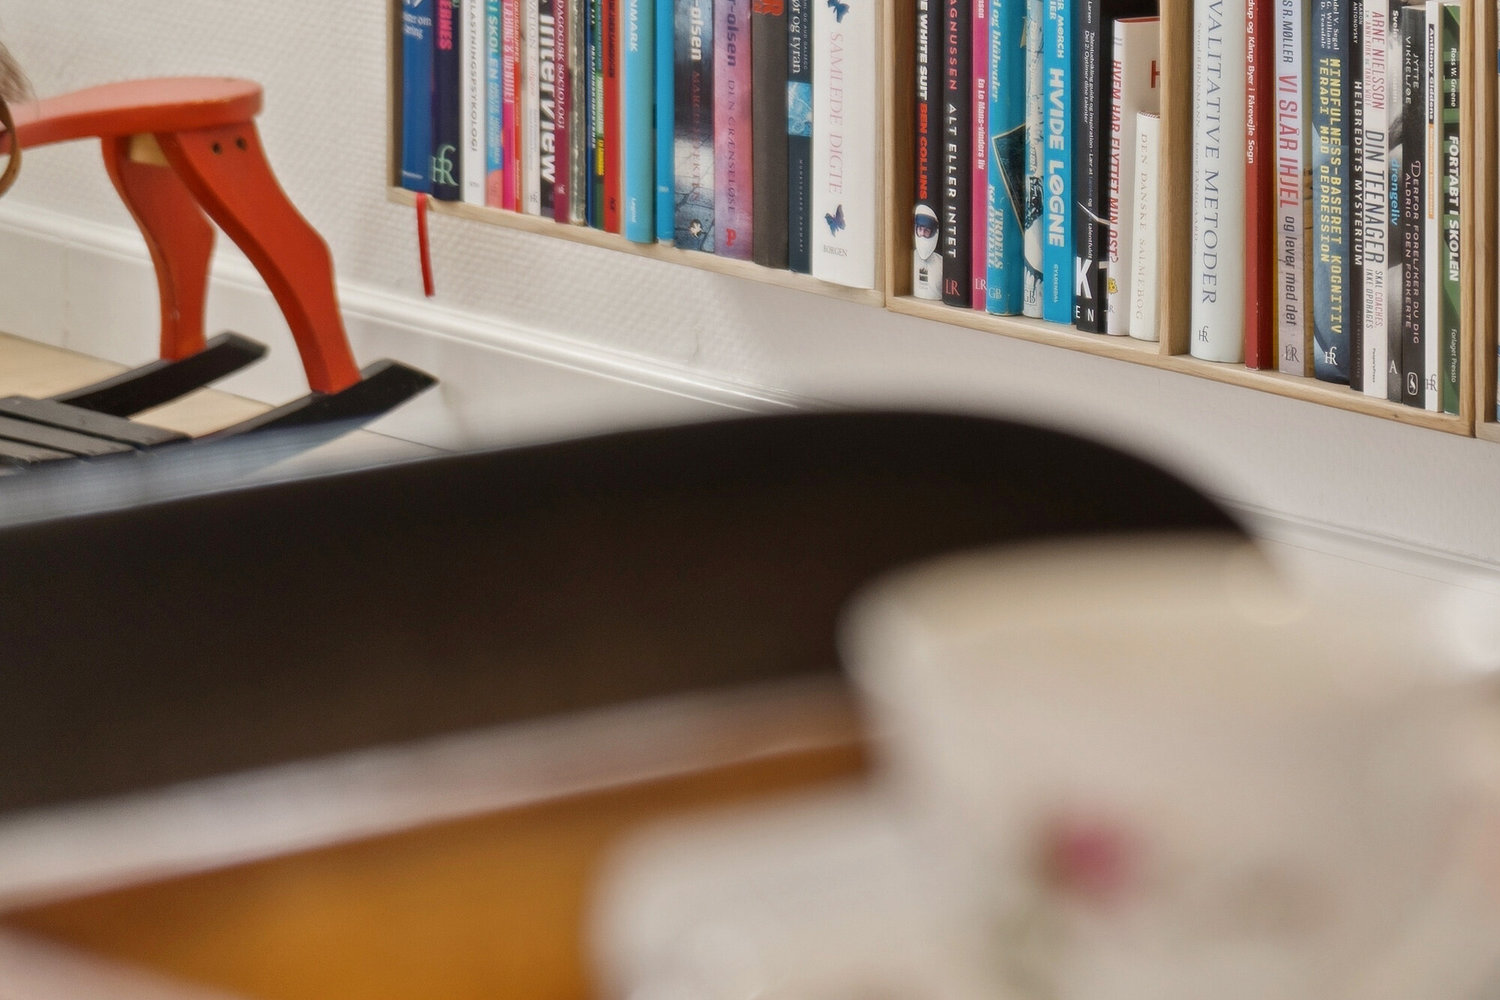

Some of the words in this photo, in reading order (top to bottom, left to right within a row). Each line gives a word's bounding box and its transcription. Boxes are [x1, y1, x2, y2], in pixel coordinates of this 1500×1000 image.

[790, 16, 801, 33] og
[919, 14, 928, 64] WHITE
[991, 9, 1000, 28] og
[1246, 21, 1254, 33] og
[1282, 20, 1294, 64] MØLLER
[1372, 11, 1385, 43] ARNE
[489, 15, 499, 80] SKOLEN
[790, 37, 802, 74] tyran
[991, 31, 1002, 103] blåhvaler
[1246, 36, 1256, 62] Kårup
[556, 64, 565, 129] SOCIOLOGI
[829, 32, 844, 126] SAMLEDE
[919, 65, 928, 101] SUIT
[1112, 60, 1122, 99] HVEM
[1246, 65, 1255, 85] Byer
[1279, 75, 1298, 93] VI
[1320, 58, 1329, 115] TERAPI
[1371, 49, 1385, 109] NIELSSON
[919, 103, 928, 135] BEN
[948, 104, 957, 137] ALT
[1049, 68, 1065, 150] HVIDE
[1111, 105, 1121, 131] HAR
[1246, 94, 1256, 136] Fårevejle
[1279, 100, 1300, 149] SLÅR
[1354, 80, 1362, 173] HELBREDETS
[828, 133, 843, 194] DIGTE
[1247, 139, 1255, 163] Sogn
[1320, 126, 1329, 154] MOD
[1330, 58, 1341, 244] MINDFULNESS-BASERET
[1365, 129, 1385, 163] DIN
[919, 137, 928, 199] COLLINS
[948, 143, 957, 198] ELLER
[1110, 137, 1120, 194] FLYTTET
[1279, 156, 1299, 208] IHJEL
[1449, 135, 1459, 206] FORTABT
[1048, 160, 1065, 247] LØGNE
[1109, 198, 1119, 224] MIN
[1140, 172, 1148, 230] DANSKE
[1319, 165, 1329, 262] DEPRESSION
[1364, 170, 1385, 263] TEENAGER
[1390, 159, 1400, 226] drengeliv
[948, 206, 957, 258] INTET
[994, 208, 1004, 271] TROELS
[1108, 229, 1119, 264] OST?
[1202, 168, 1219, 304] METODER
[1283, 215, 1295, 231] og
[1354, 179, 1362, 266] MYSTERIUM
[822, 245, 848, 257] BORGEN
[1284, 235, 1298, 268] lever
[1449, 219, 1459, 282] SKOLEN
[1136, 238, 1146, 320] SALMEBOG
[1285, 272, 1298, 300] med
[1330, 255, 1341, 334] KOGNITIV
[1286, 304, 1298, 326] det
[1365, 288, 1374, 329] OPDRAGES
[1413, 301, 1419, 318] DU
